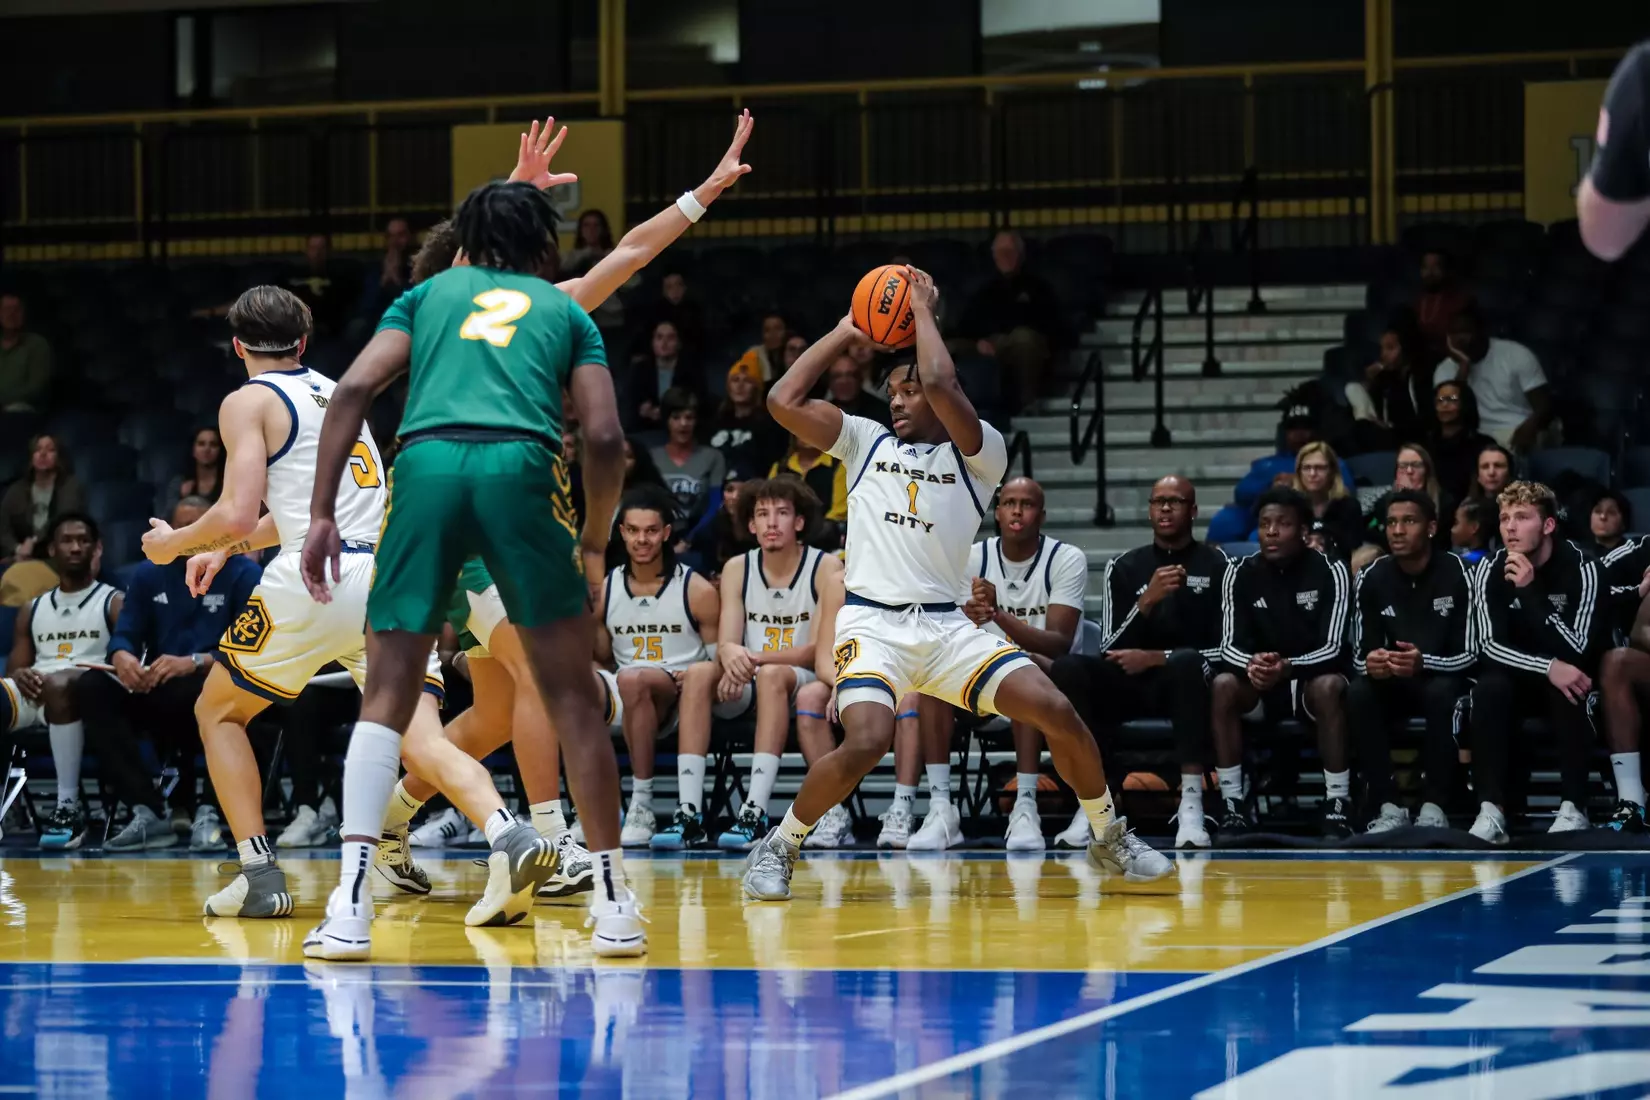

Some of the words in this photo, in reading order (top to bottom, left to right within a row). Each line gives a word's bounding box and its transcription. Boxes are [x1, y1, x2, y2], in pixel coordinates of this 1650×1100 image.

[877, 276, 900, 315] NCAA
[459, 287, 532, 348] 2
[906, 480, 919, 516] 1
[884, 511, 935, 533] CITY
[37, 630, 100, 642] KANSAS
[614, 624, 682, 635] KANSAS
[762, 627, 796, 651] 35
[631, 636, 664, 662] 25
